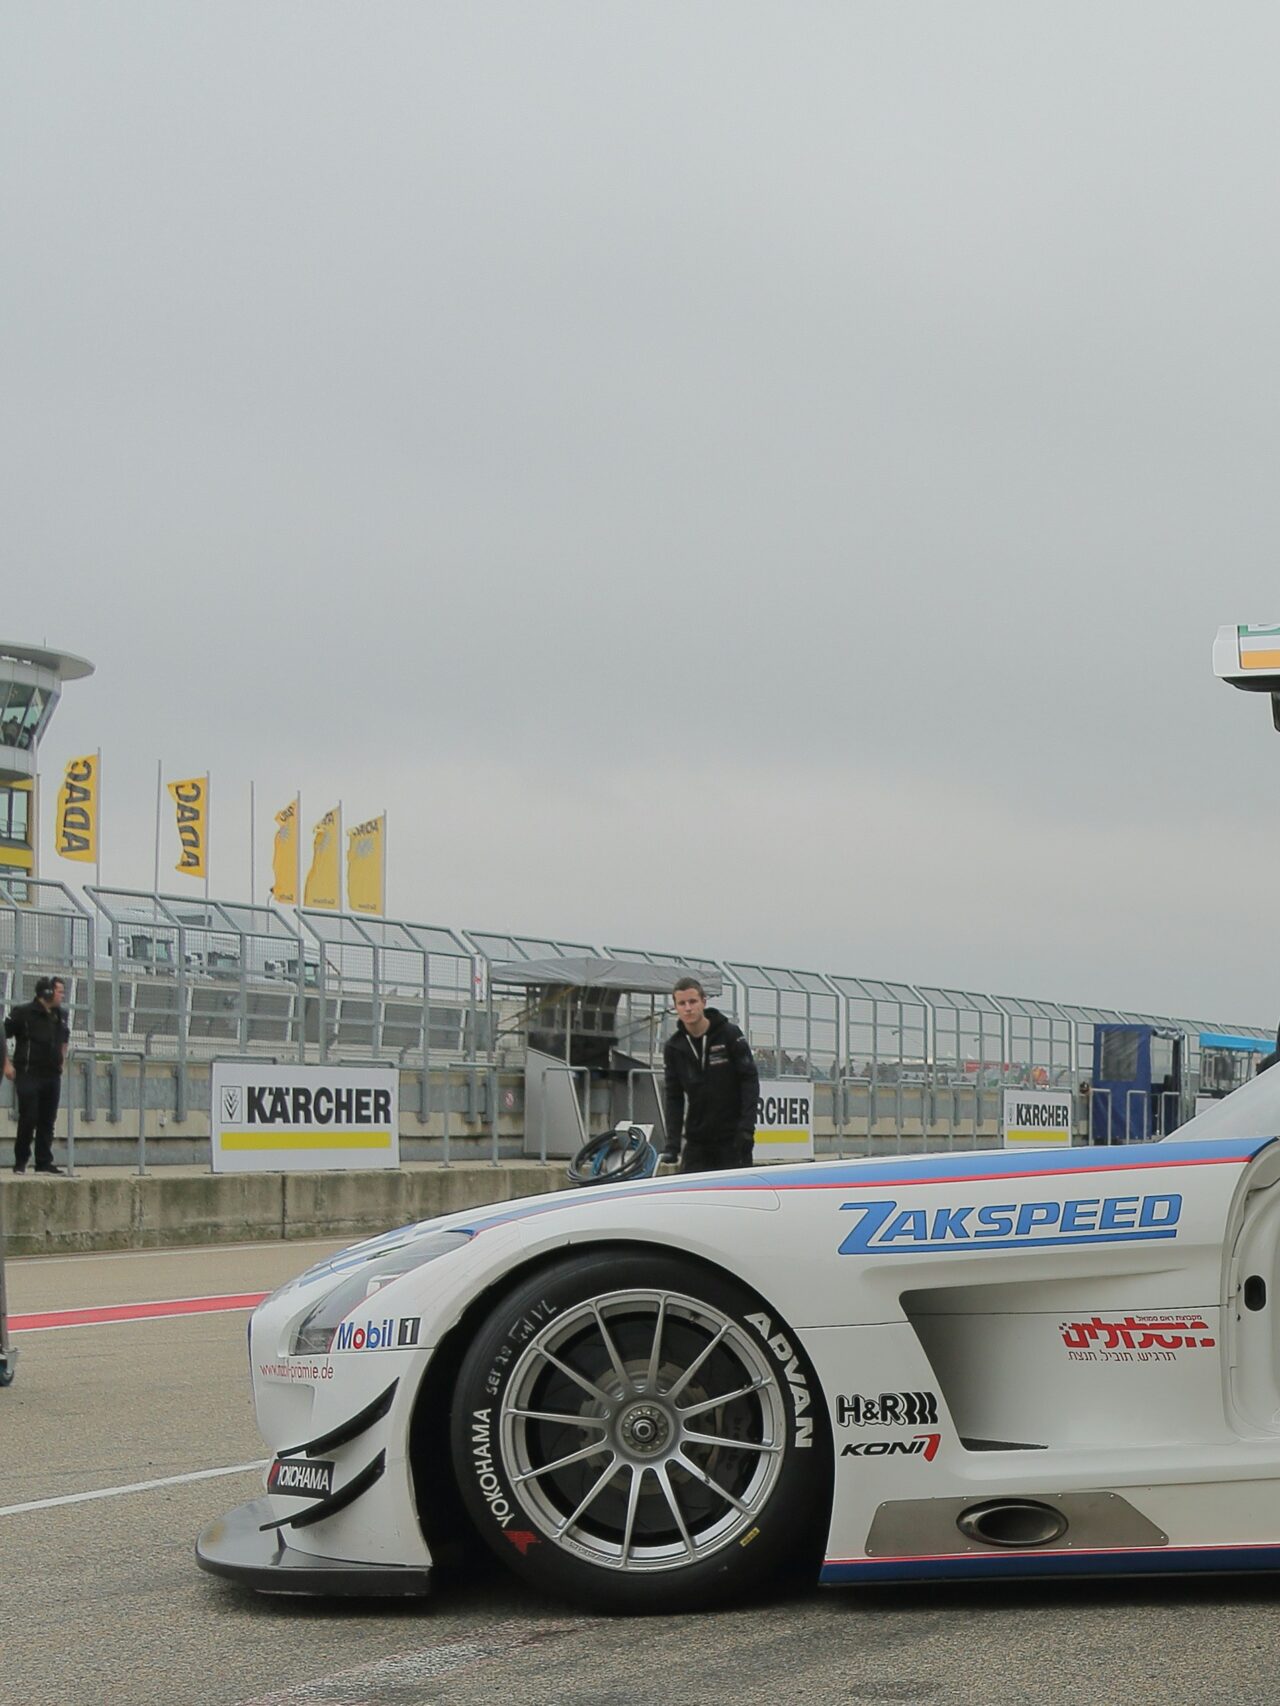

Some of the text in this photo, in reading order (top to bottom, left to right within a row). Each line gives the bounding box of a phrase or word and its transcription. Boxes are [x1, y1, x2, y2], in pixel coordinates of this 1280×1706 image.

[247, 1087, 392, 1125] KÄRCHER
[754, 1097, 809, 1125] RCHER
[1016, 1103, 1069, 1127] KÄRCHER
[838, 1194, 1182, 1255] ZAKSPEED
[337, 1318, 417, 1350] Mobil 1
[743, 1312, 813, 1448] ADVAN
[837, 1394, 911, 1428] H&R
[840, 1434, 941, 1461] KONI
[277, 1466, 329, 1491] YOKOHAMA
[472, 1408, 515, 1528] YOKOHAMA
